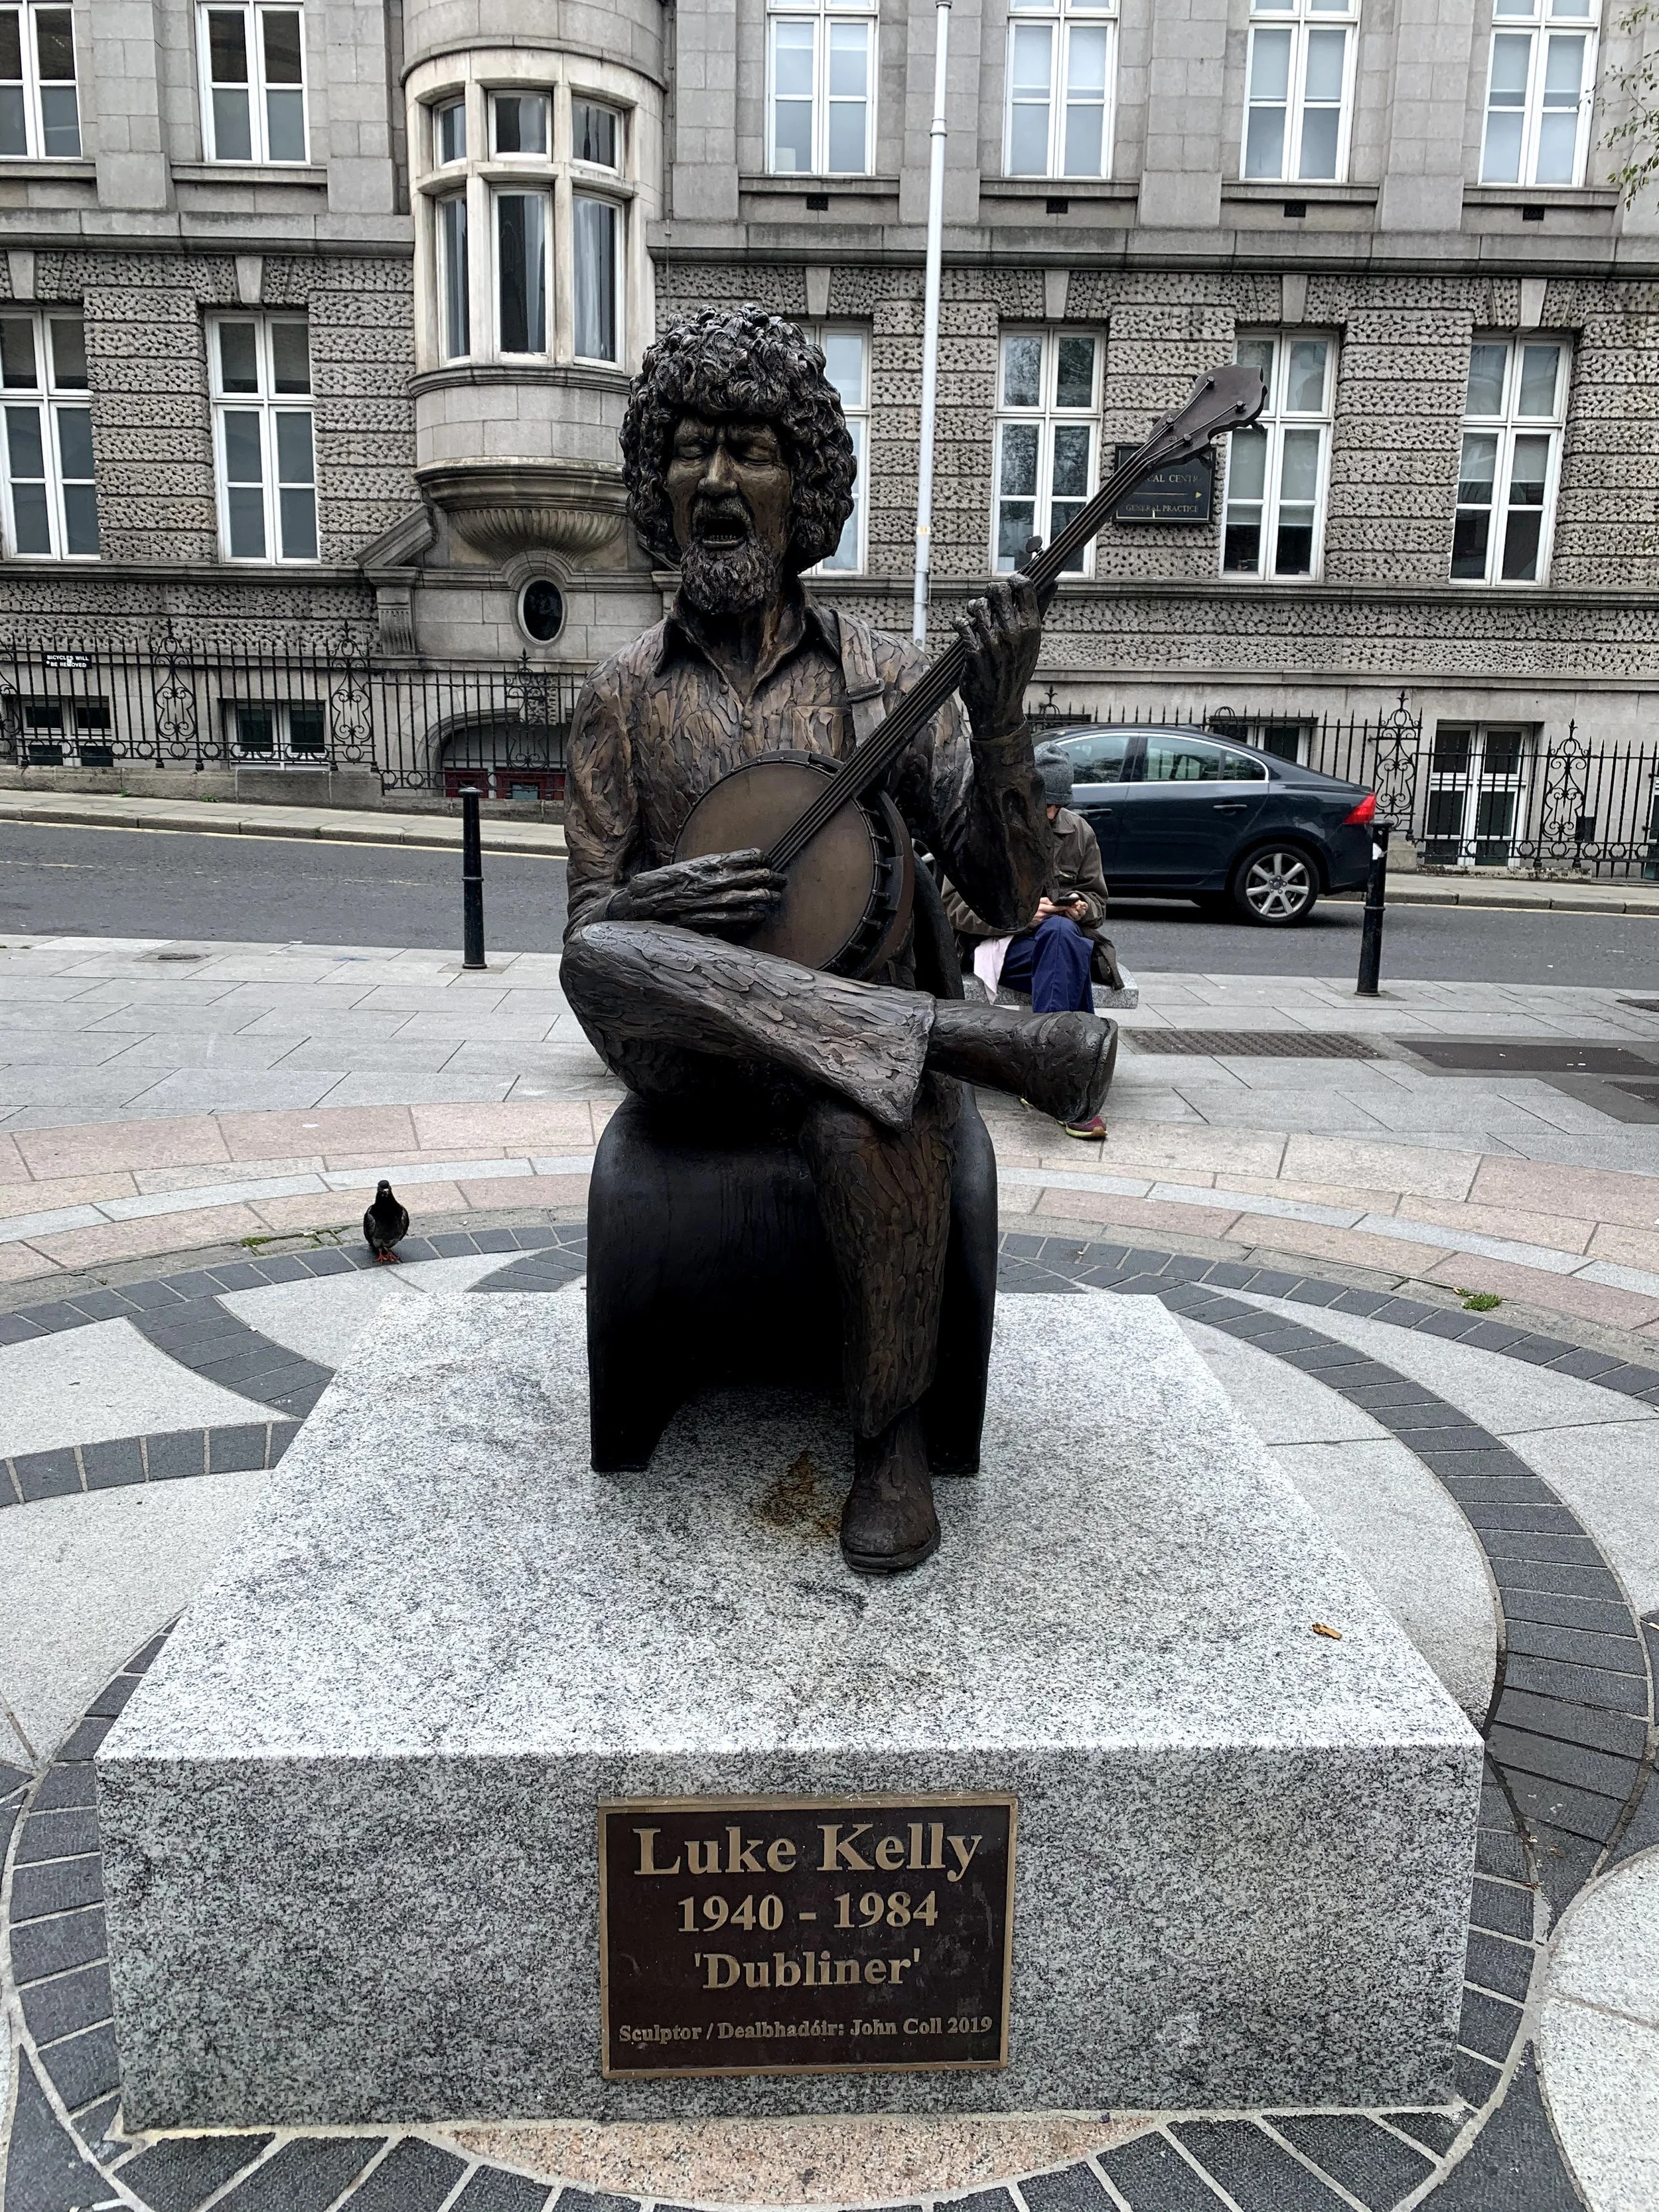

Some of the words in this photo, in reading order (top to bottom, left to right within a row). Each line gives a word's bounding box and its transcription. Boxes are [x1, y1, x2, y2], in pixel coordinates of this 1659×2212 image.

[632, 1826, 797, 1876] Luke
[816, 1822, 983, 1882] Kelly
[678, 1893, 784, 1933] 1940
[799, 1911, 818, 1921] -
[833, 1890, 938, 1929] 1984
[695, 1948, 920, 1990] 'Dubliner'
[619, 2024, 702, 2045] Sculptor
[705, 2022, 714, 2040] /
[717, 2020, 845, 2039] Dealbhadóir:
[850, 2019, 898, 2036] John
[902, 2017, 943, 2035] Coll
[947, 2016, 993, 2034] 2019
